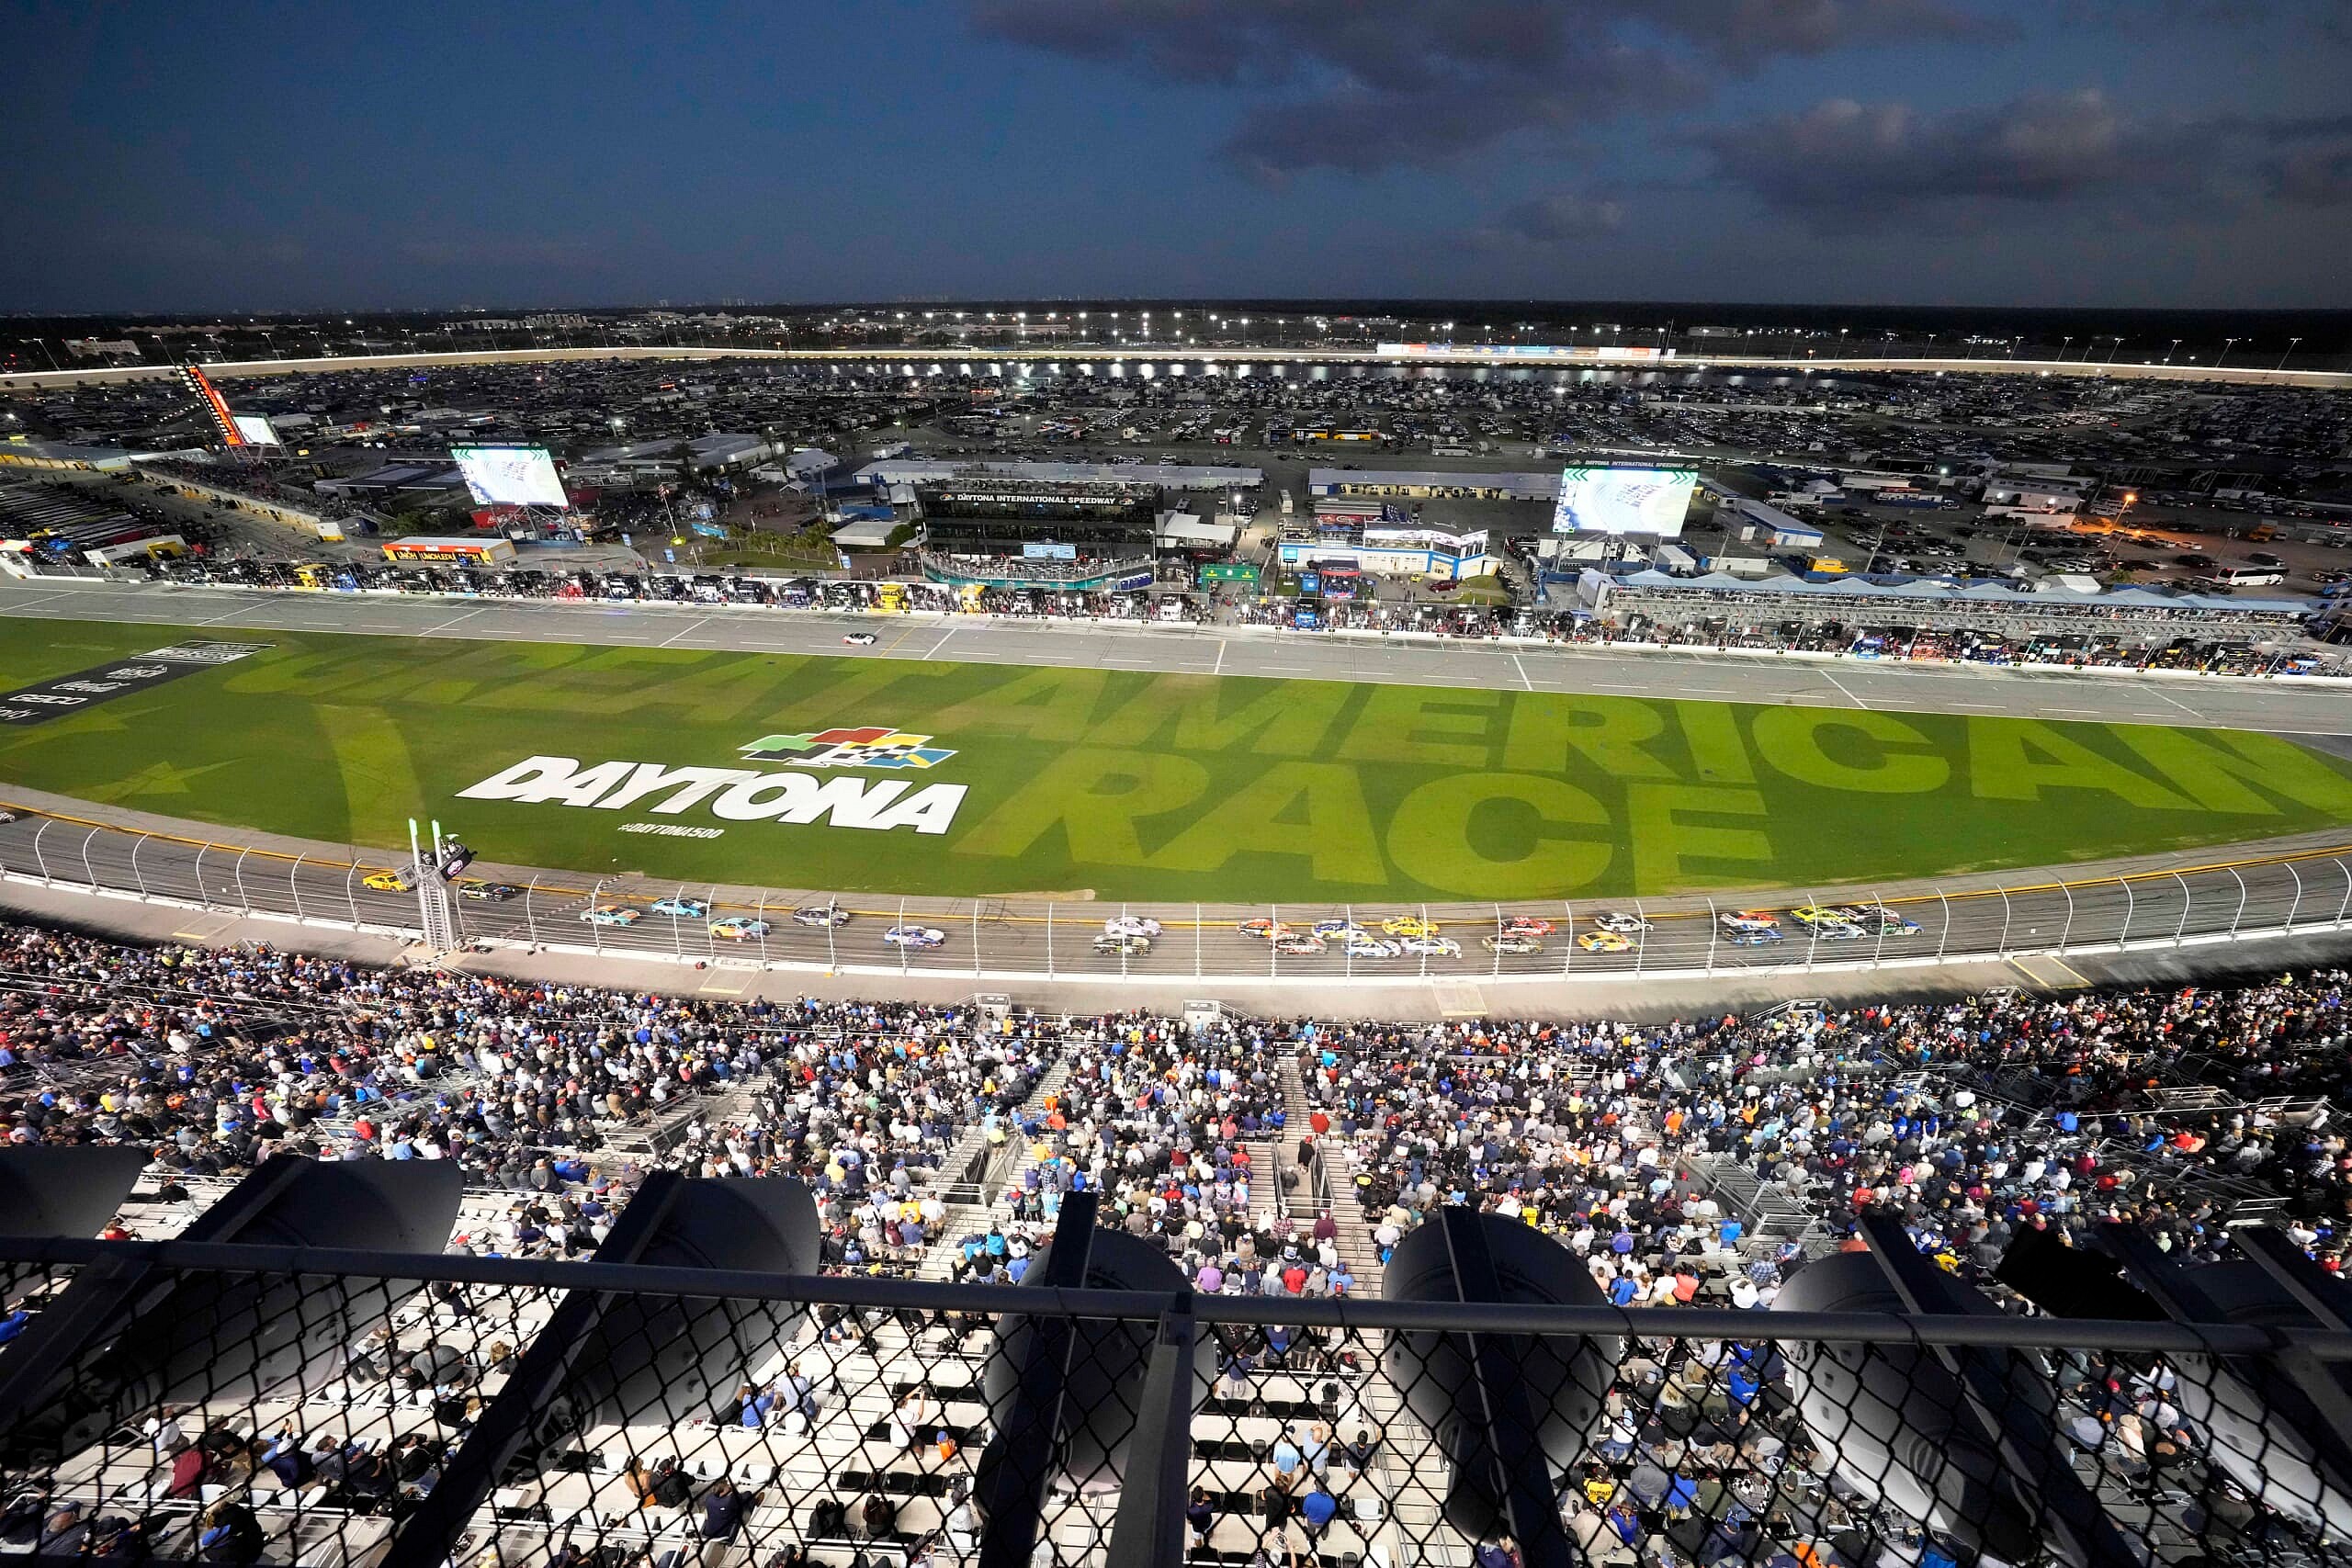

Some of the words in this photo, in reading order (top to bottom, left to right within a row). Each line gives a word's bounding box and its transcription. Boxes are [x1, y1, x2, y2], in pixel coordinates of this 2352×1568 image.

[957, 493, 995, 502] DAYTONA
[997, 494, 1066, 503] INTERNATIONAL
[1068, 496, 1116, 504] SPEEDWAY
[7, 694, 89, 705] GEICO
[896, 665, 2352, 818] AMERICAN
[453, 754, 969, 836] DAYTONA
[616, 823, 725, 839] #DAYTONA500
[948, 746, 1774, 897] RACE
